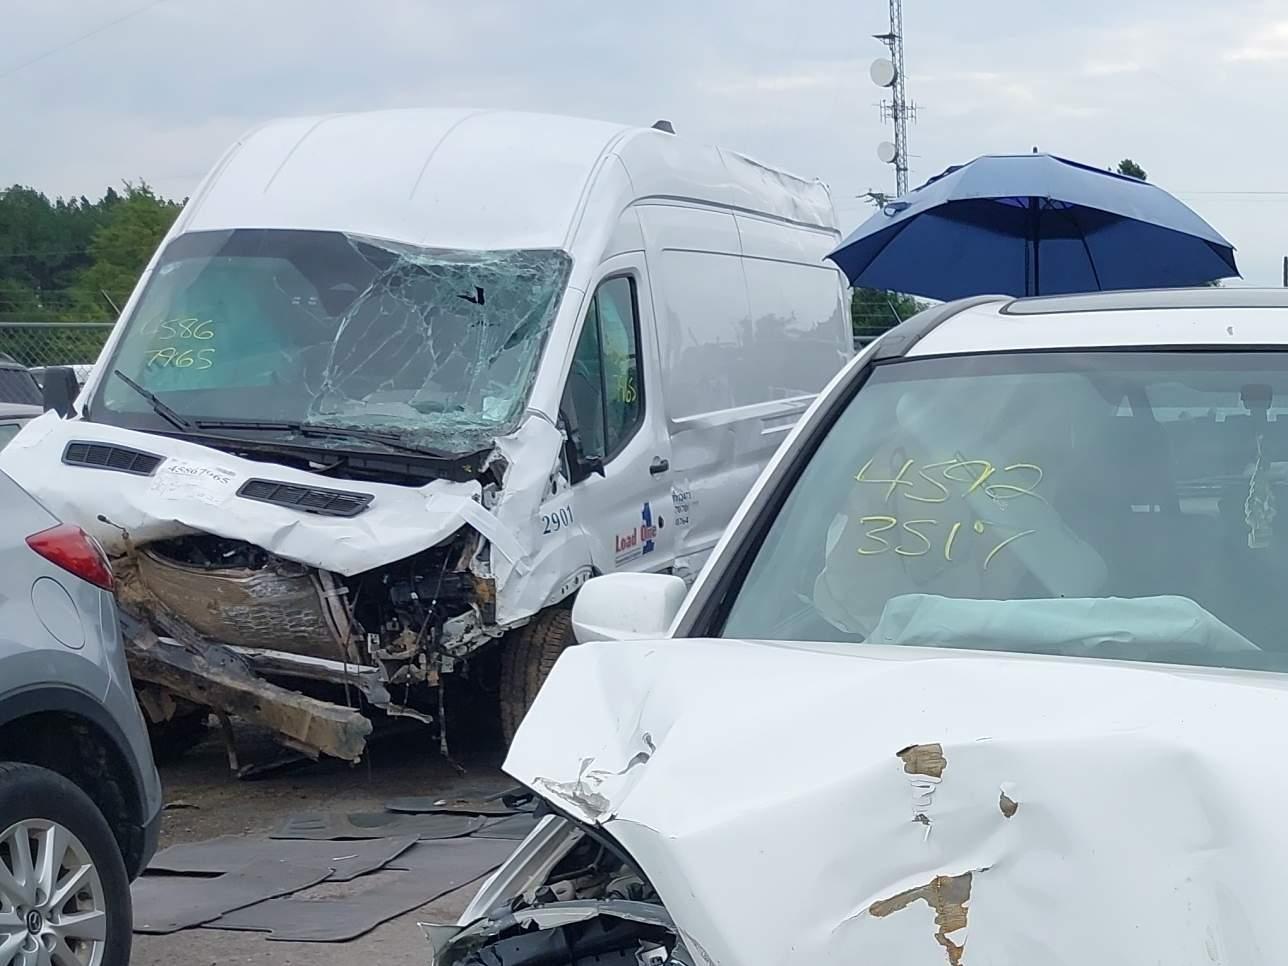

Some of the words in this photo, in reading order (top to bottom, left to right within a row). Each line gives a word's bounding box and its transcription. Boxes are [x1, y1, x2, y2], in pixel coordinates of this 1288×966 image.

[854, 457, 1049, 504] 4592
[542, 505, 574, 535] 2901
[615, 527, 637, 553] Load
[640, 524, 657, 543] One
[856, 515, 1036, 570] 3517
